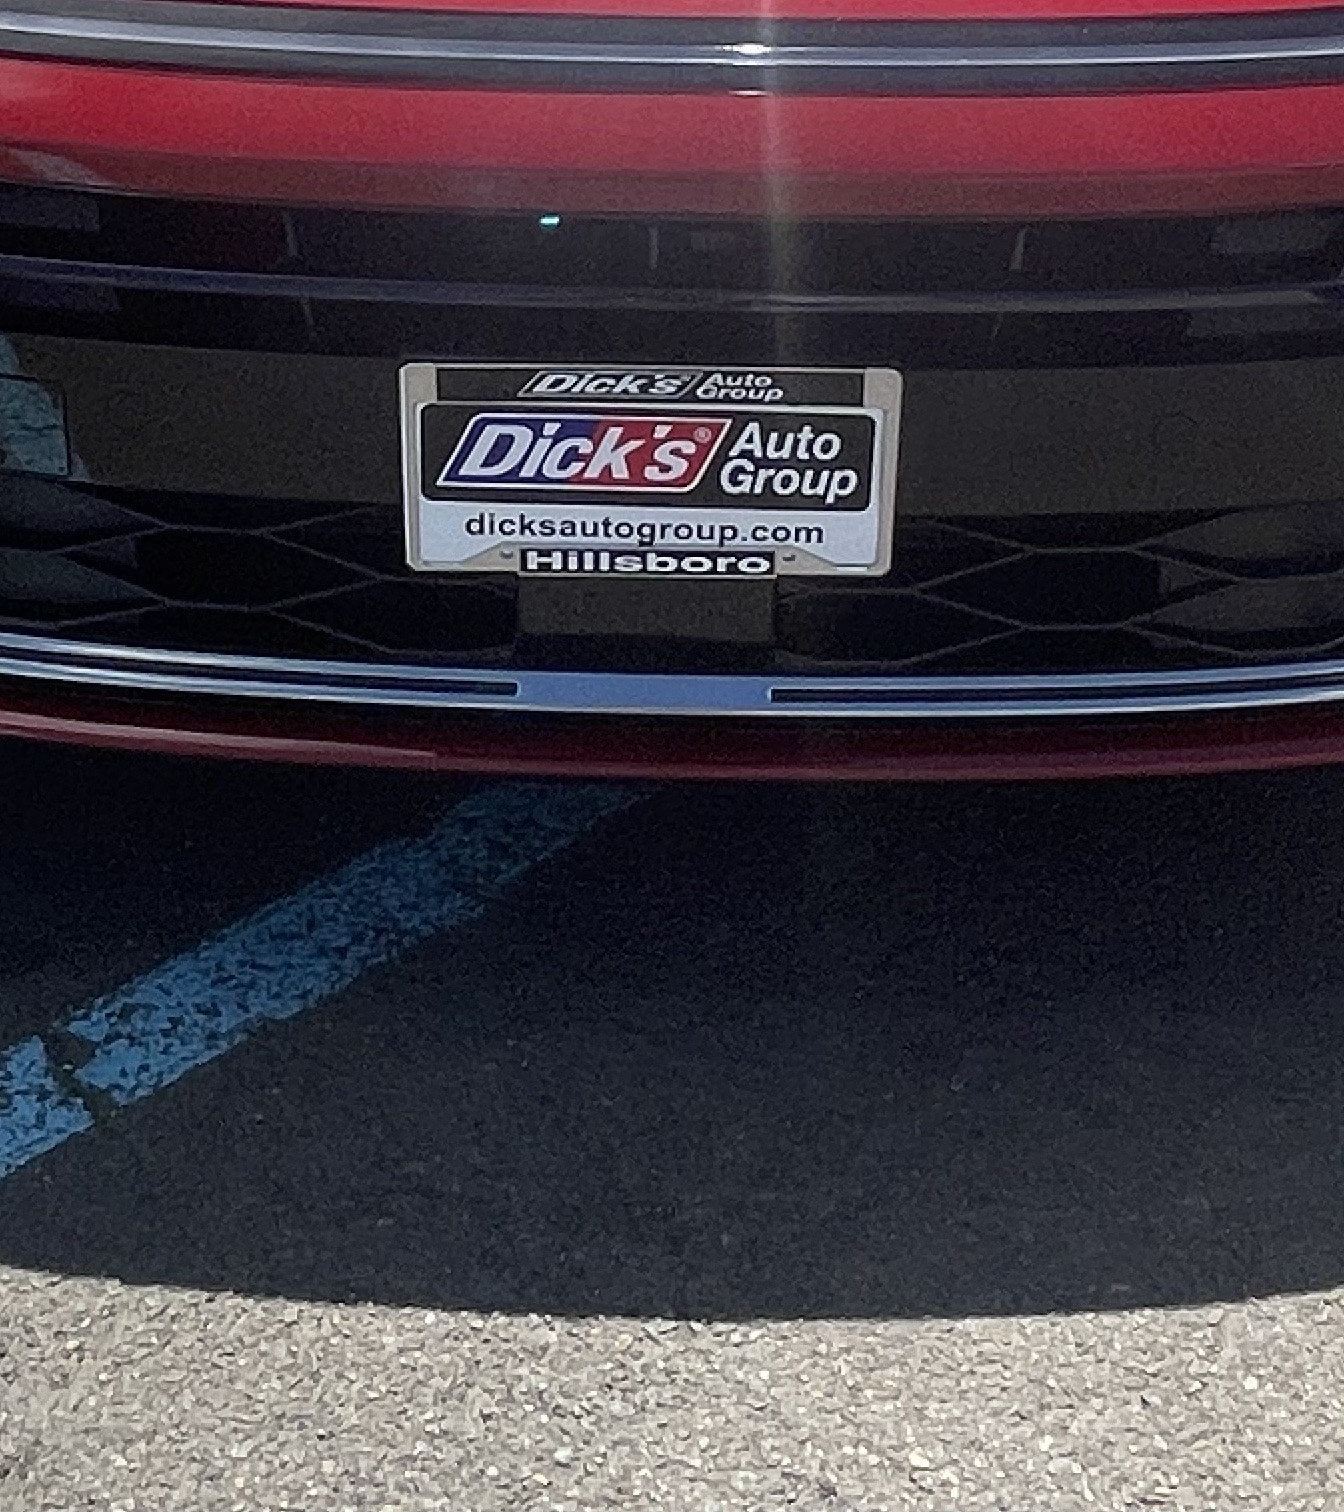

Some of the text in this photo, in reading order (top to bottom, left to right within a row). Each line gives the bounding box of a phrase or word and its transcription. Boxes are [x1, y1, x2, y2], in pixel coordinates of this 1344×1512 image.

[706, 372, 772, 388] Auto
[695, 387, 784, 402] Group
[457, 421, 842, 481] Dick's Auto
[719, 459, 858, 504] Group
[464, 513, 825, 547] dicksautogroup.com
[525, 550, 771, 573] Hillsboro
